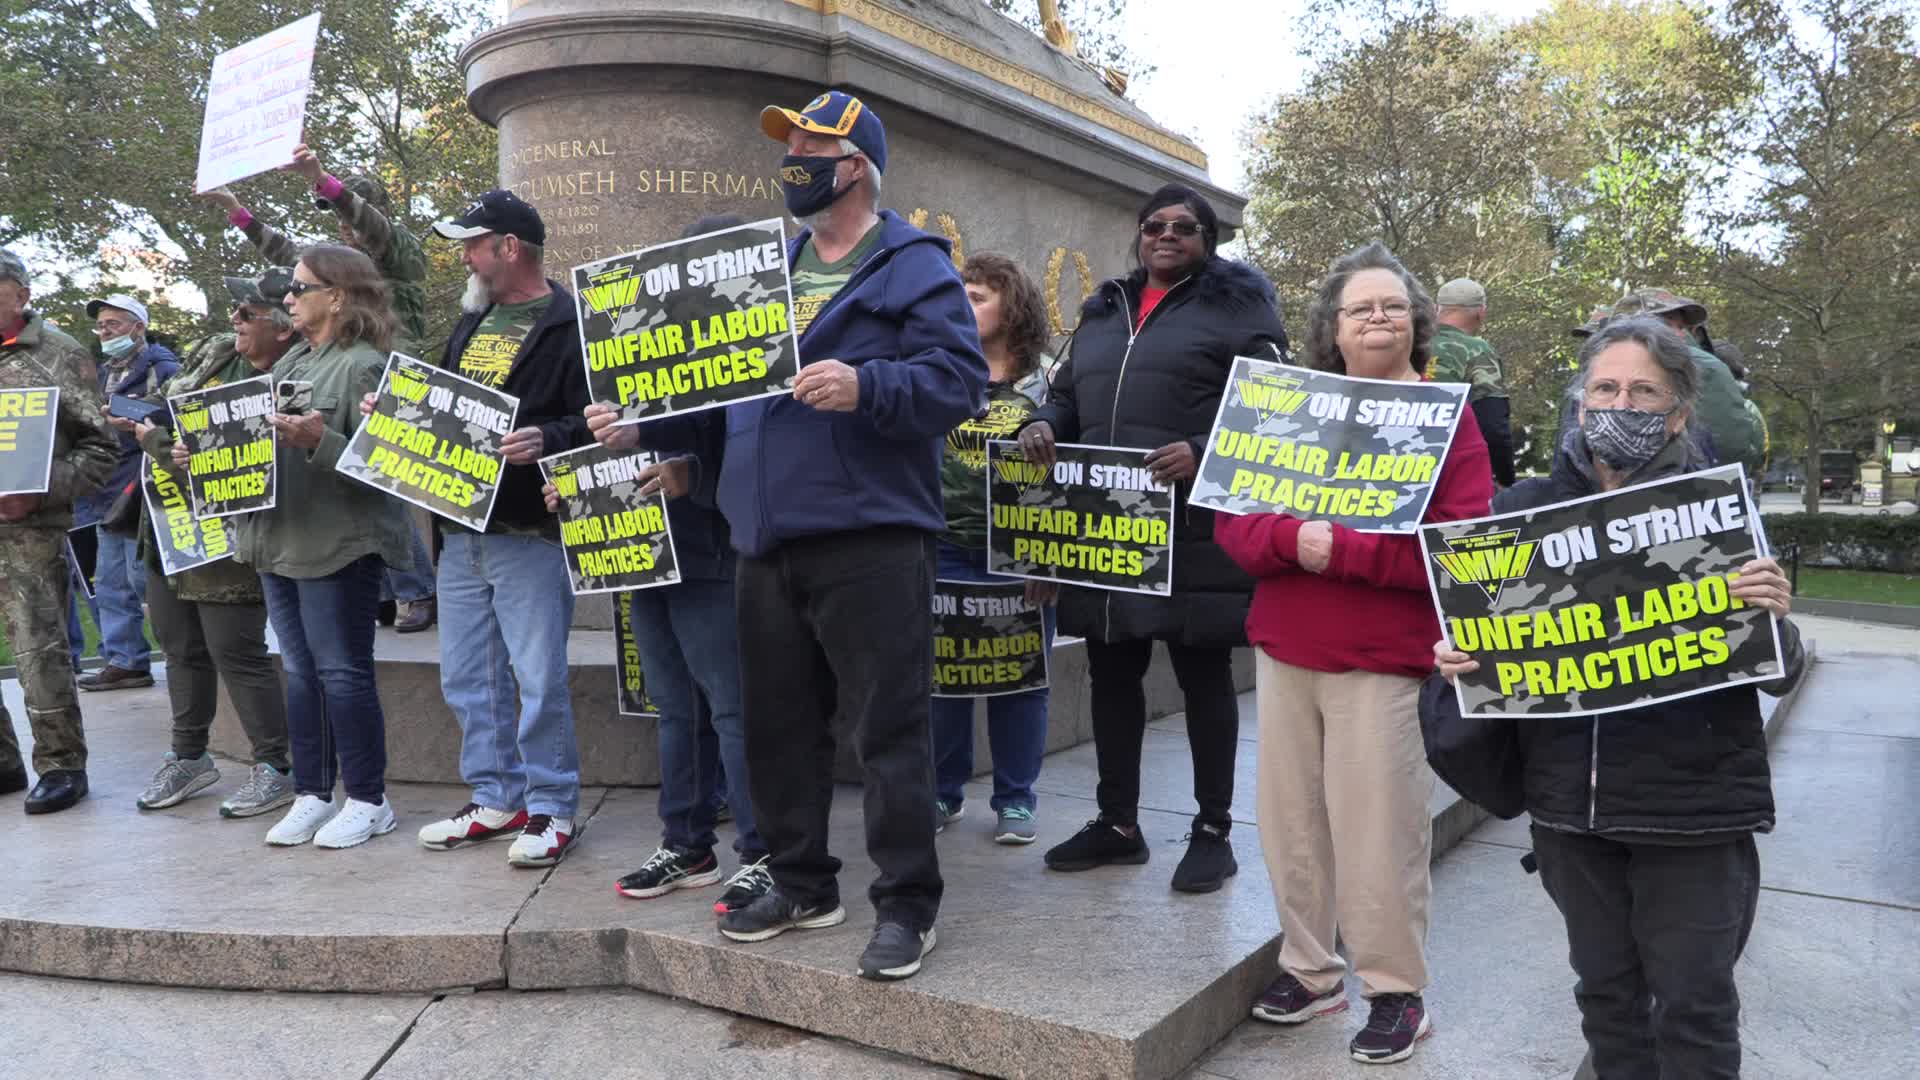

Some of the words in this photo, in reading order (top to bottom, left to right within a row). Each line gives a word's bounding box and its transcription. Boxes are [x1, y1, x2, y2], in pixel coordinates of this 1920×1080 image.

[522, 138, 616, 164] GENERAL
[645, 263, 680, 296] ON
[687, 242, 781, 287] STRIKE
[495, 342, 520, 354] ONE
[588, 324, 686, 372] UNFAIR
[691, 302, 788, 349] LABOR
[616, 347, 767, 406] PRACTICES
[0, 391, 49, 418] RE
[210, 402, 230, 425] ON
[230, 392, 272, 421] STRIKE
[429, 386, 454, 413] ON
[454, 396, 511, 435] STRIKE
[1000, 406, 1030, 419] ONE
[1309, 392, 1350, 422] ON
[1356, 400, 1456, 427] STRIKE
[191, 447, 234, 476] UNFAIR
[235, 438, 273, 468] LABOR
[366, 411, 437, 458] UNFAIR
[437, 439, 499, 485] LABOR
[1215, 429, 1329, 477] UNFAIR
[1335, 452, 1437, 484] LABOR
[204, 471, 265, 503] PRACTICES
[367, 446, 476, 508] PRACTICES
[577, 466, 595, 491] ON
[1054, 462, 1083, 485] ON
[1229, 469, 1397, 518] PRACTICES
[152, 464, 197, 551] ACTICES
[562, 516, 605, 546] UNFAIR
[604, 505, 665, 540] LABOR
[994, 504, 1078, 536] UNFAIR
[1085, 513, 1168, 545] LABOR
[200, 518, 228, 558] BOR
[1542, 526, 1597, 568] ON
[1606, 494, 1745, 554] STRIKE
[577, 543, 655, 577] PRACTICES
[1014, 538, 1143, 576] PRACTICES
[1435, 543, 1534, 583] UMWA
[932, 594, 957, 616] ON
[963, 632, 1041, 659] LABOR
[1450, 602, 1606, 652] UNFAIR
[933, 660, 1023, 686] ACTICES
[1496, 627, 1729, 696] PRACTICES
